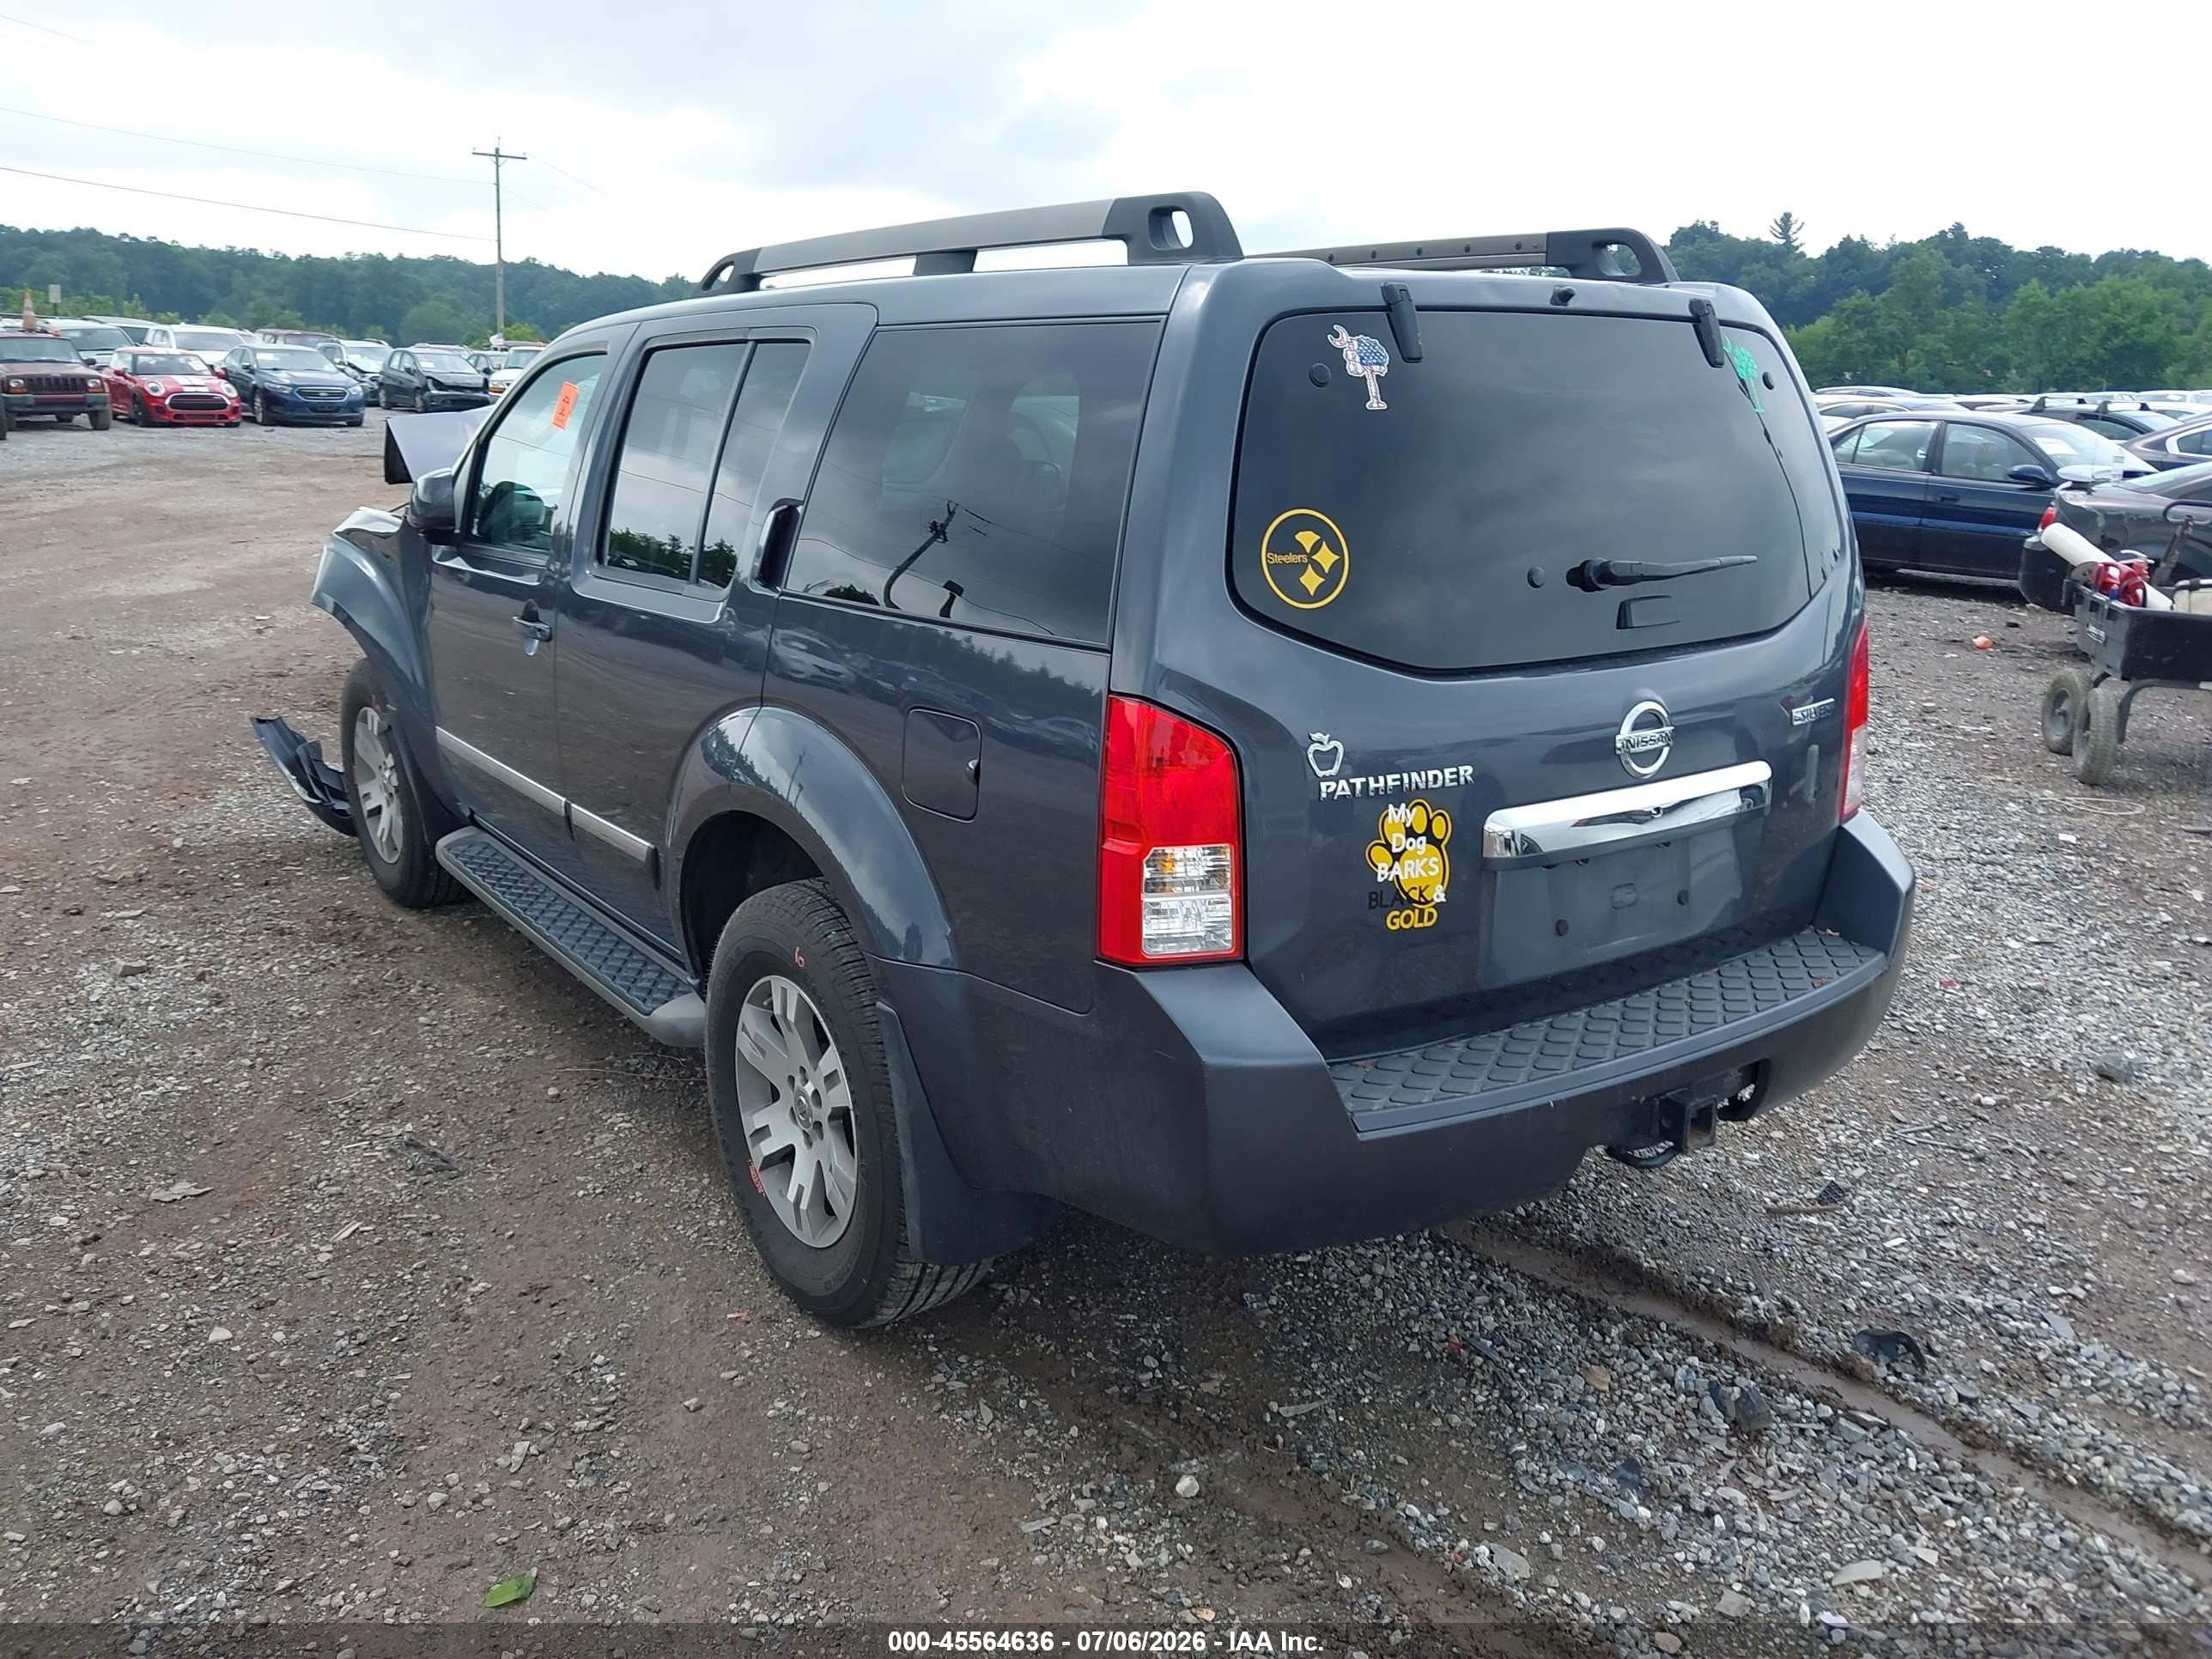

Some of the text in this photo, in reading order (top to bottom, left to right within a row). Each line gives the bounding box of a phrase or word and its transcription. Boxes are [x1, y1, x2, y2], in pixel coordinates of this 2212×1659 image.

[1267, 552, 1309, 564] Steelers
[1623, 730, 1674, 750] NISSAN
[1320, 765, 1474, 800] PATHFINDER
[1388, 803, 1417, 827] My
[1392, 833, 1426, 855] Dog
[1376, 856, 1439, 882] BARKS
[1368, 884, 1447, 909] BLACK &
[1386, 907, 1438, 931] GOLD
